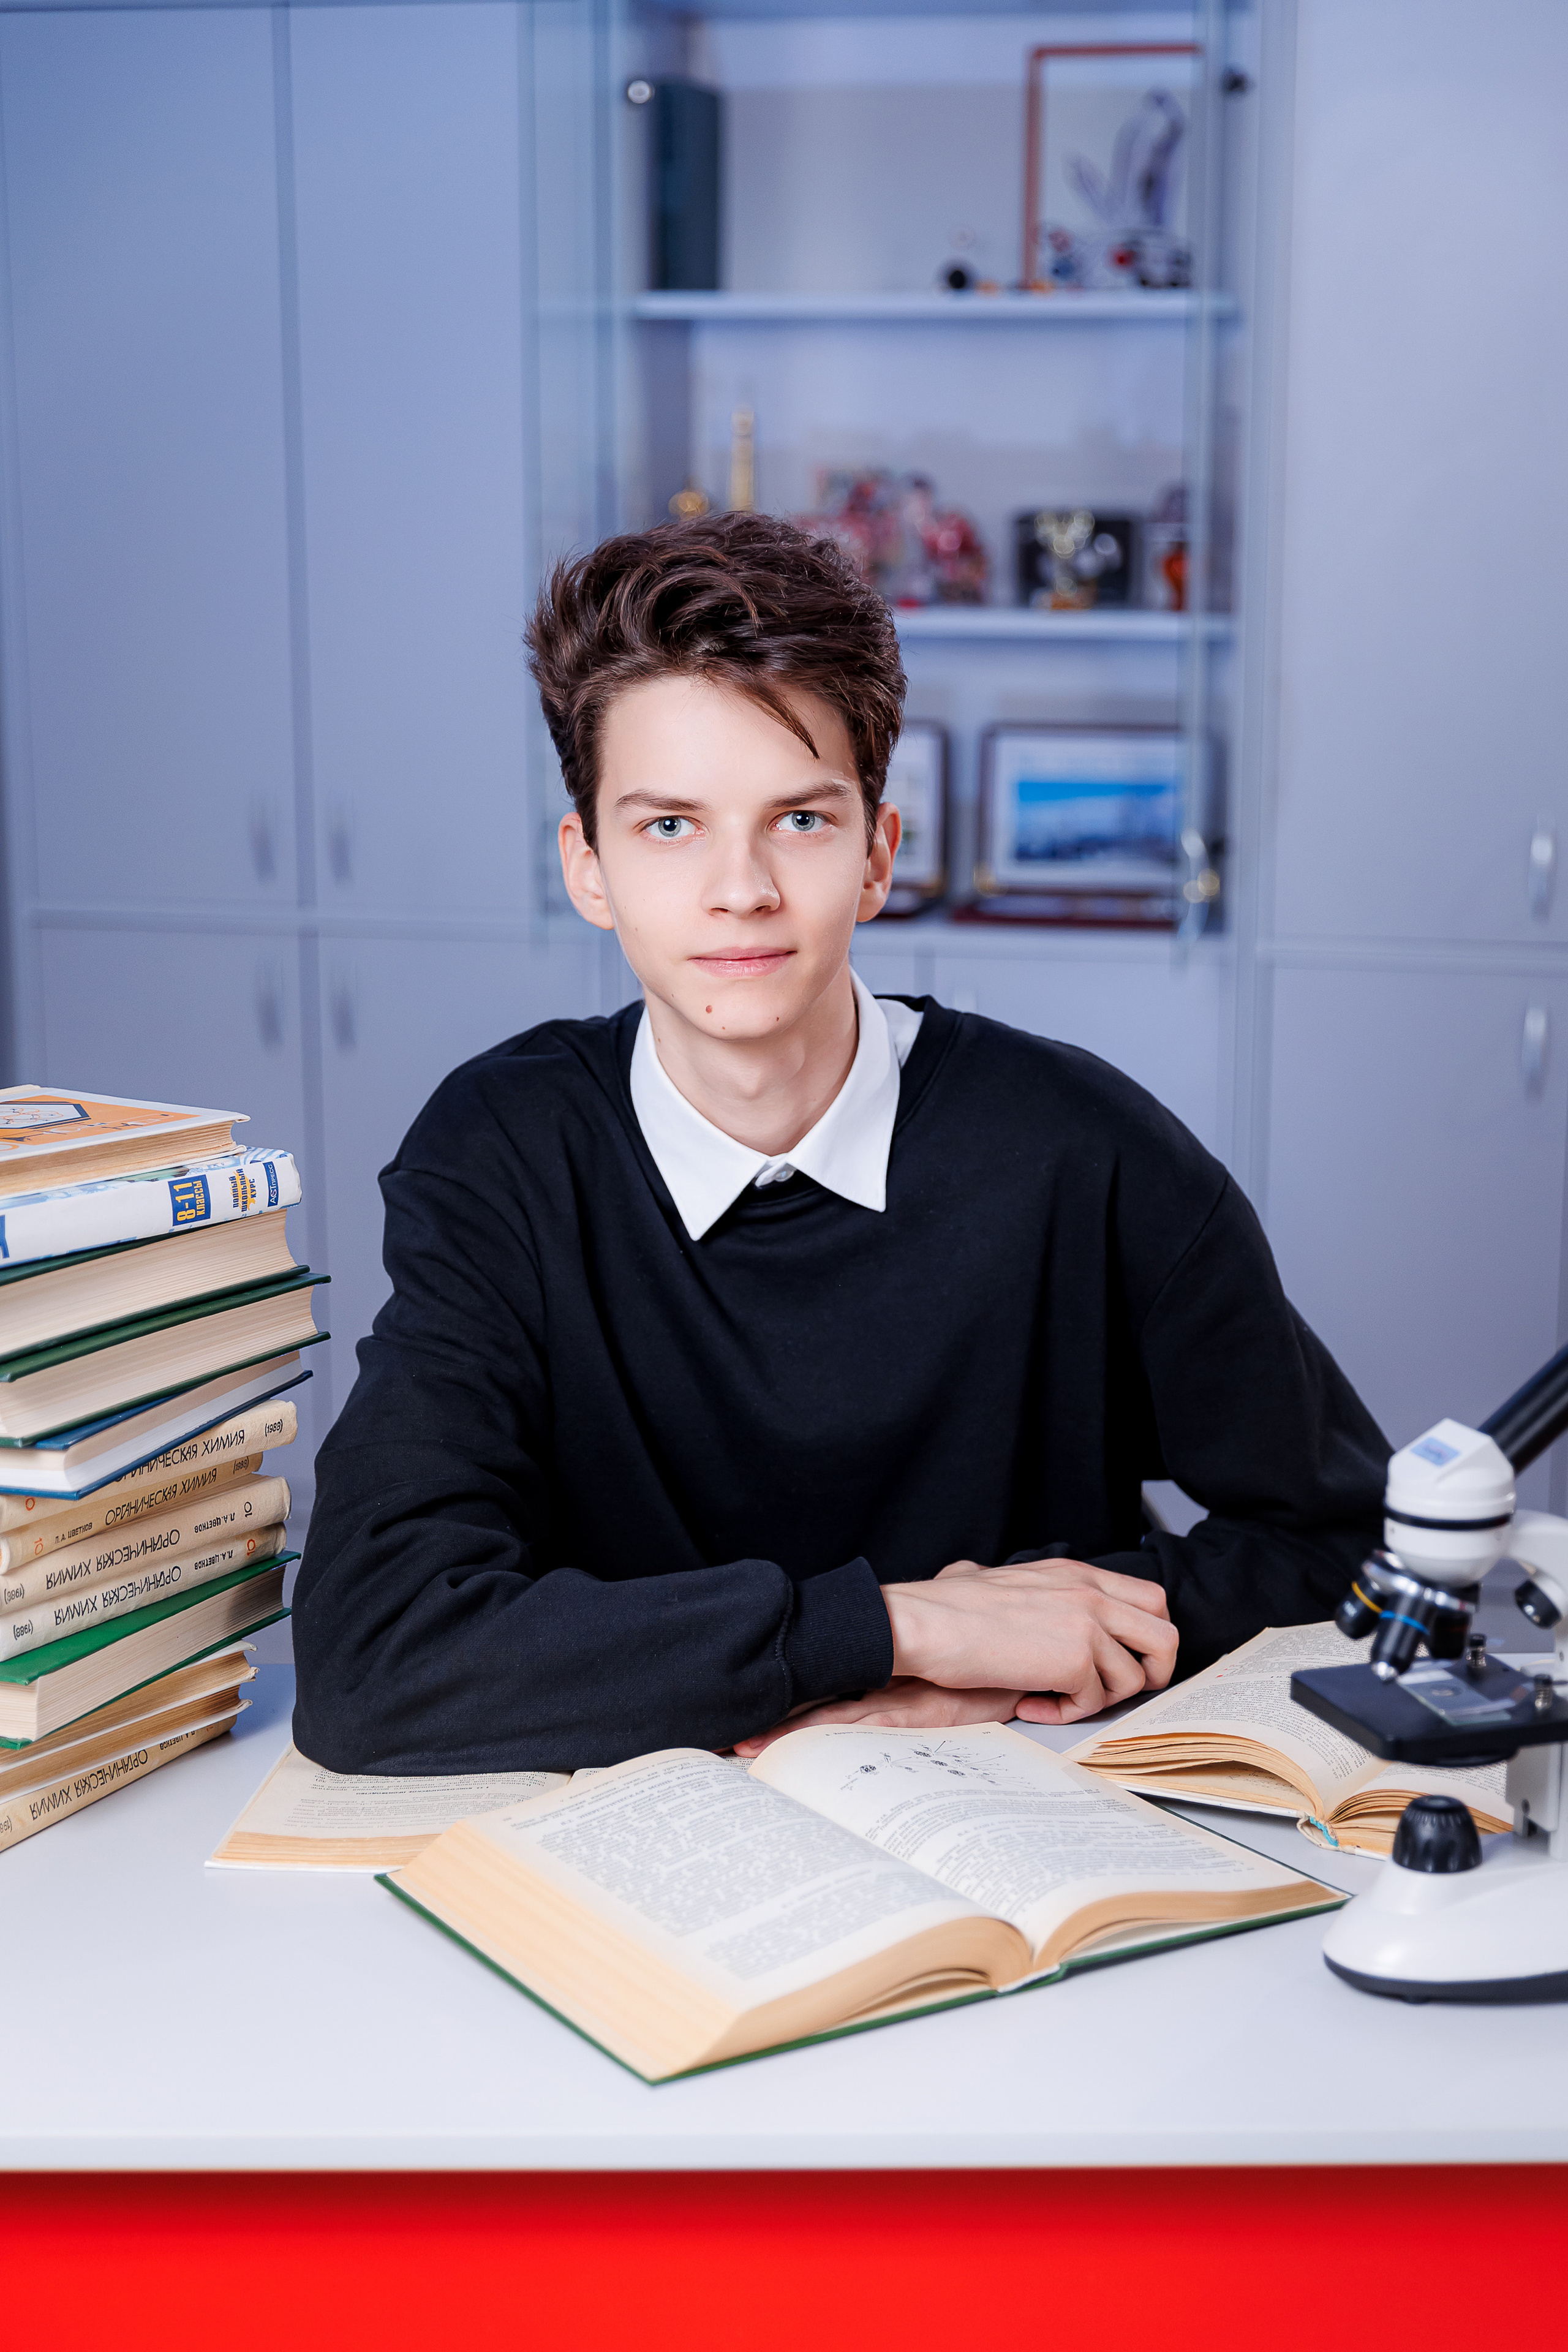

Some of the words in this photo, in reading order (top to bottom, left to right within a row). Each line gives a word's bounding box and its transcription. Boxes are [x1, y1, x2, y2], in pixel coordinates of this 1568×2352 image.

[173, 1182, 195, 1221] 8-11
[228, 1175, 239, 1208] ПОЛНЫЙ
[236, 1168, 247, 1213] ШКОЛЬНЫЙ
[202, 1430, 245, 1457] ХИМИЯ
[67, 1522, 92, 1539] ЦВЕТКОВ
[105, 1483, 178, 1526] ОРГАНИЧЕСКАЯ
[179, 1468, 217, 1496] ХИМИЯ
[244, 1501, 252, 1518] 10
[96, 1529, 180, 1572] ОРГАНИЧЕСКАЯ
[247, 1539, 256, 1556] 10
[45, 1559, 91, 1590] ХИМИЯ
[102, 1566, 181, 1608] ОРГАНИЧЕСКАЯ
[54, 1595, 97, 1626] ХИМИЯ
[13, 1619, 34, 1640] (1988)
[74, 1749, 148, 1798] ОРГАНИЧЕСКАЯ
[29, 1785, 72, 1821] ХИМИЯ
